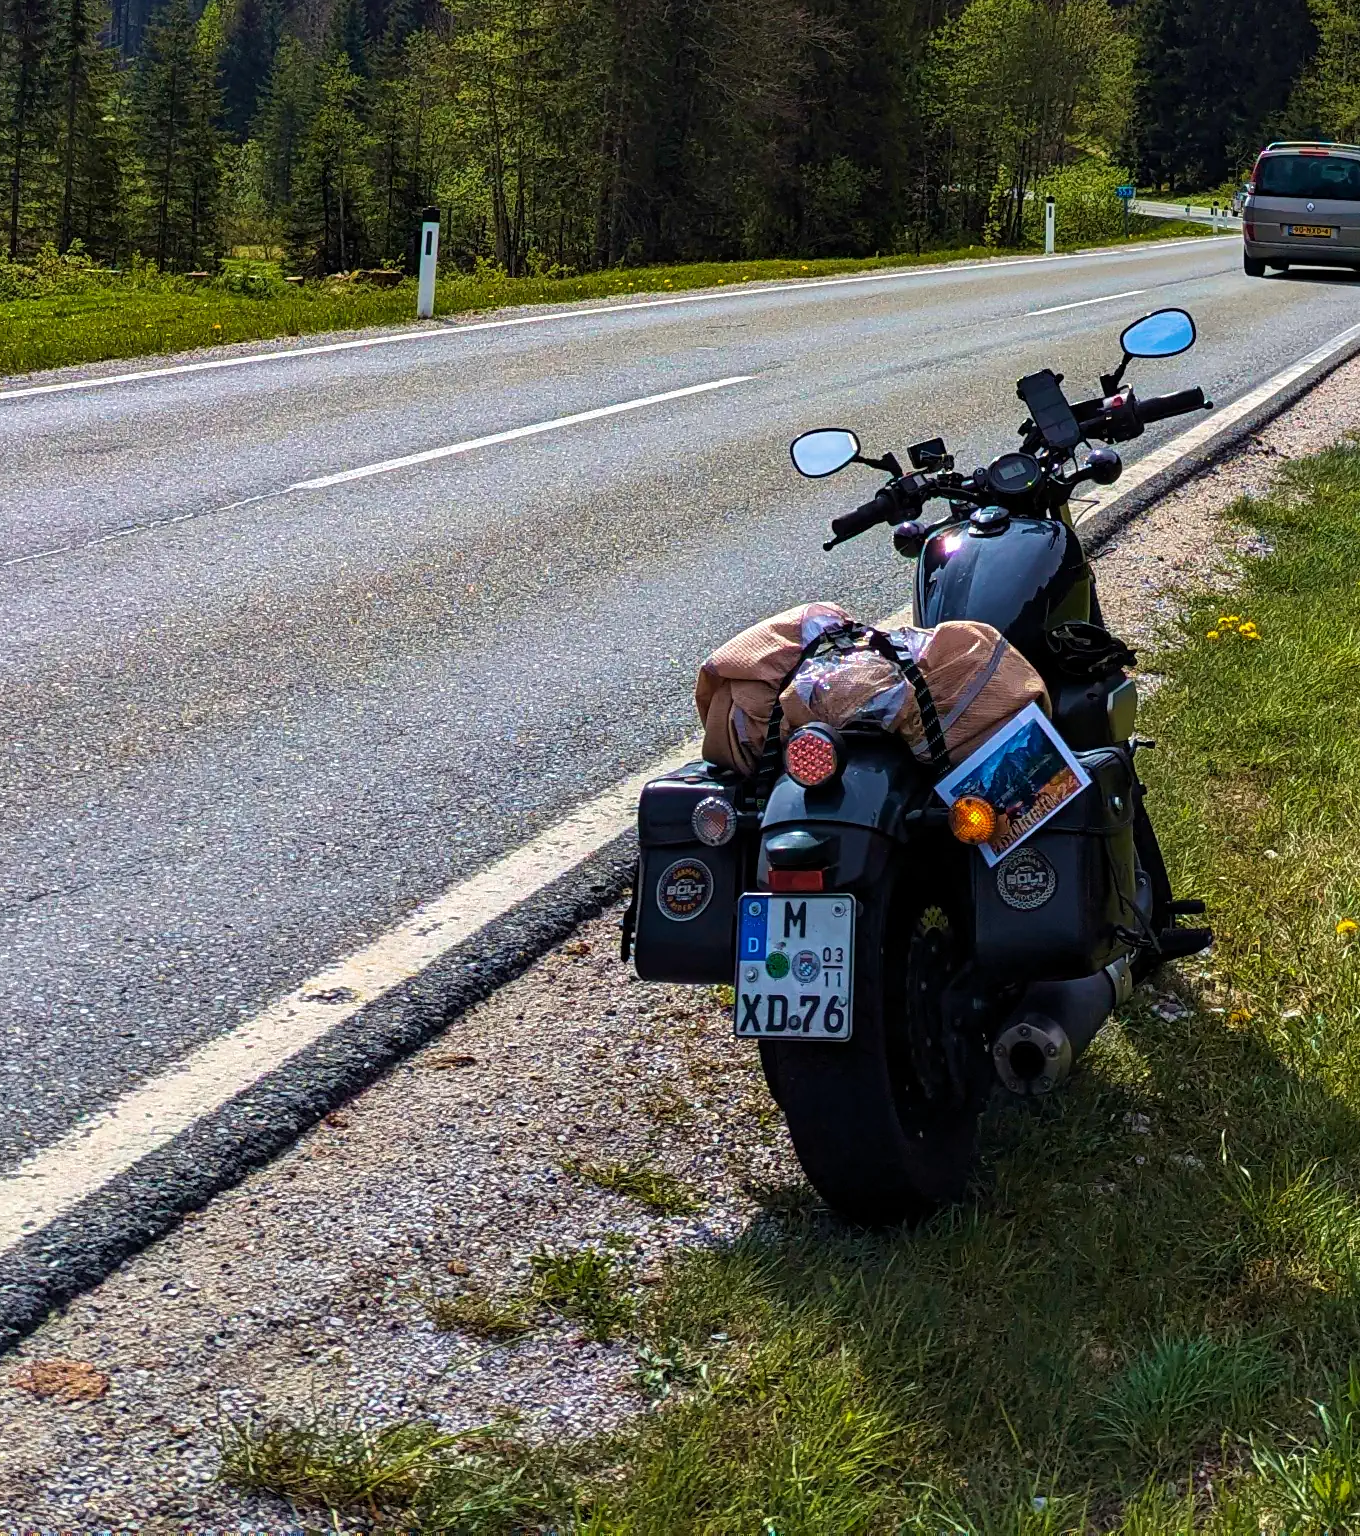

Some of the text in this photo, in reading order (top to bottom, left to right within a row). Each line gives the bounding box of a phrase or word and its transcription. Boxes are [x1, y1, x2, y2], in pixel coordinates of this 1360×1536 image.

[1006, 871, 1047, 885] BOLT
[666, 884, 706, 895] BOLT
[783, 901, 807, 938] M
[747, 937, 759, 953] D
[822, 947, 844, 963] 03
[823, 971, 842, 987] 11
[739, 994, 845, 1034] XD 76
